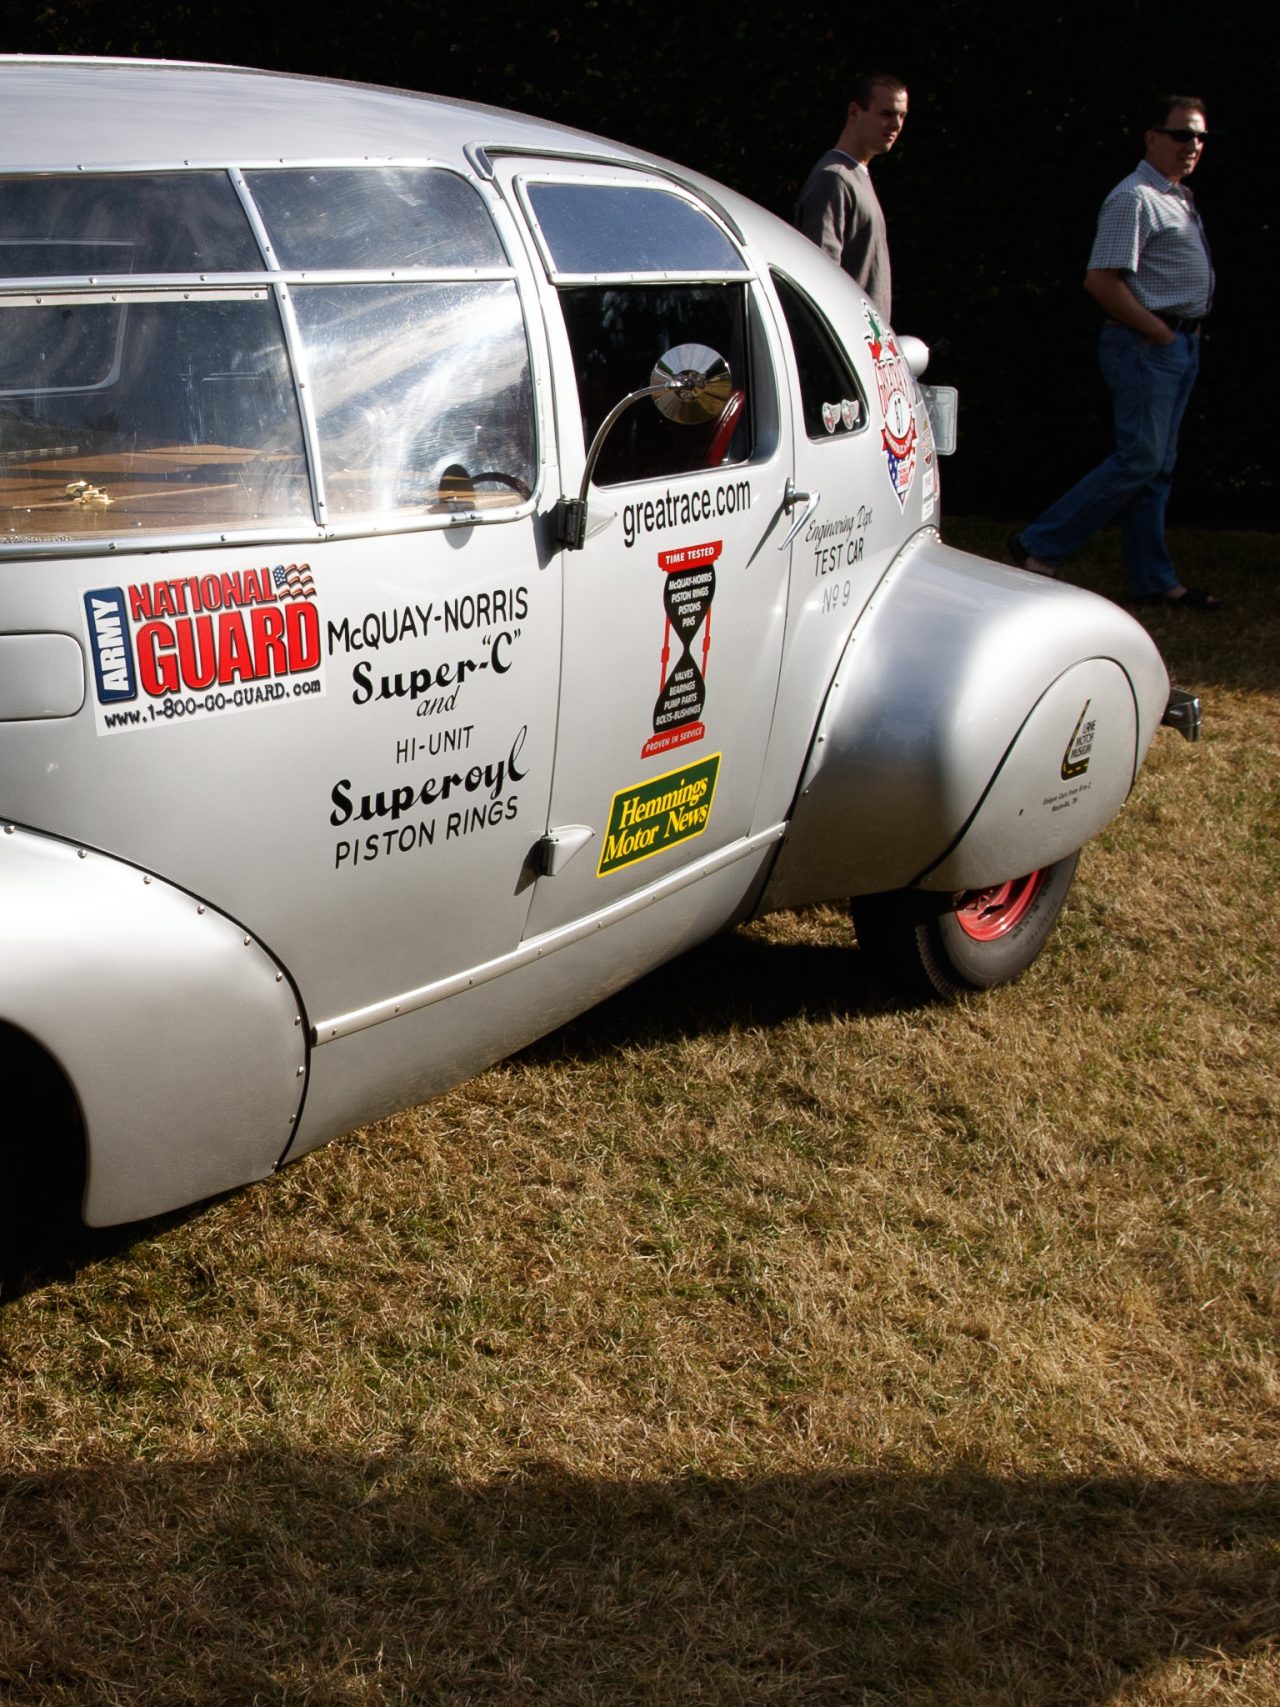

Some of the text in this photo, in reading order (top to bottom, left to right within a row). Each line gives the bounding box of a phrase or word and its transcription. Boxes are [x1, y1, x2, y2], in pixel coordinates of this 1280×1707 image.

[623, 480, 751, 549] greatrace.com
[805, 515, 855, 550] Engineering
[665, 547, 715, 565] TIME TESTED
[814, 537, 864, 577] TEST CAR
[127, 567, 276, 621] NATIONAL
[668, 571, 713, 591] McQUAY-NORRIS
[671, 586, 709, 604] PISTON RINGS
[842, 580, 851, 607] 9
[327, 586, 529, 656] McQUAY-NORRIS
[678, 601, 702, 616] PISTONS
[682, 615, 696, 628] PINS
[92, 598, 130, 693] ARMY
[136, 601, 320, 696] GUARD
[669, 680, 696, 697] BEARINGS
[674, 668, 694, 683] VALVES
[416, 685, 460, 717] and
[663, 692, 698, 711] PUMP PARTS
[396, 725, 475, 764] HI-UNIT
[645, 726, 704, 753] PROVEN IN SERVICE
[330, 724, 530, 827] Superoyl
[619, 775, 709, 831] Hemmings
[335, 795, 519, 870] PISTON RINGS
[603, 801, 709, 864] Motor News
